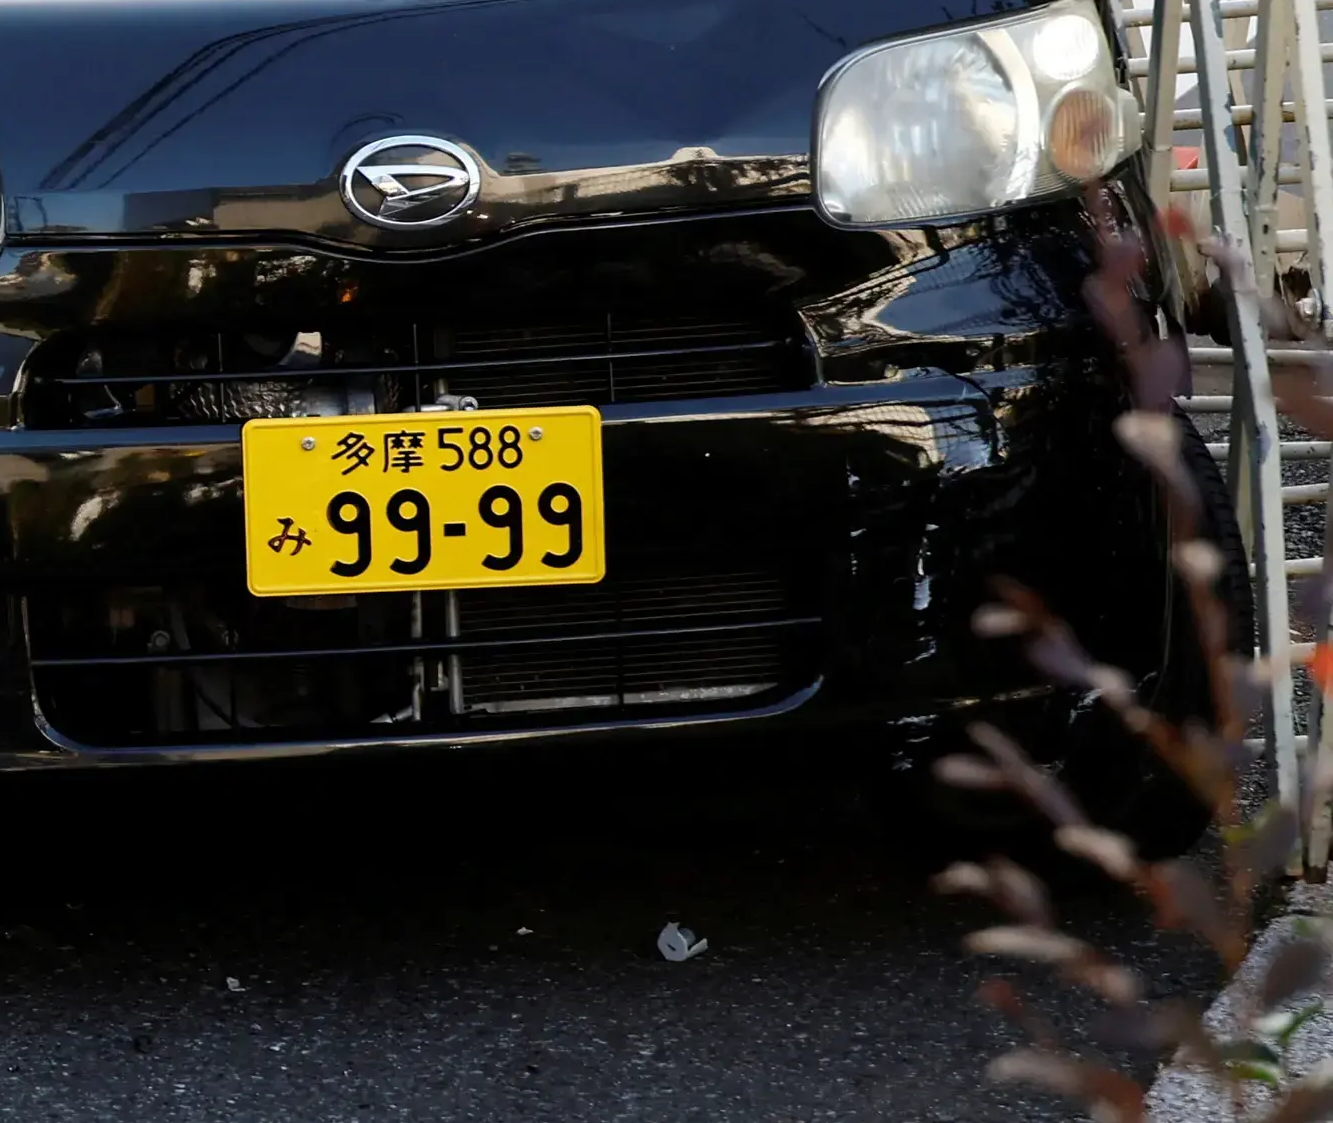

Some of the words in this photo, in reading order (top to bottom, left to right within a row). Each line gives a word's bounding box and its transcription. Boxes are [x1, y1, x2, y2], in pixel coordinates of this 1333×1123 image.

[331, 429, 426, 475] 多摩
[437, 424, 524, 472] 588
[267, 517, 312, 556] み
[326, 482, 583, 577] 99-99
